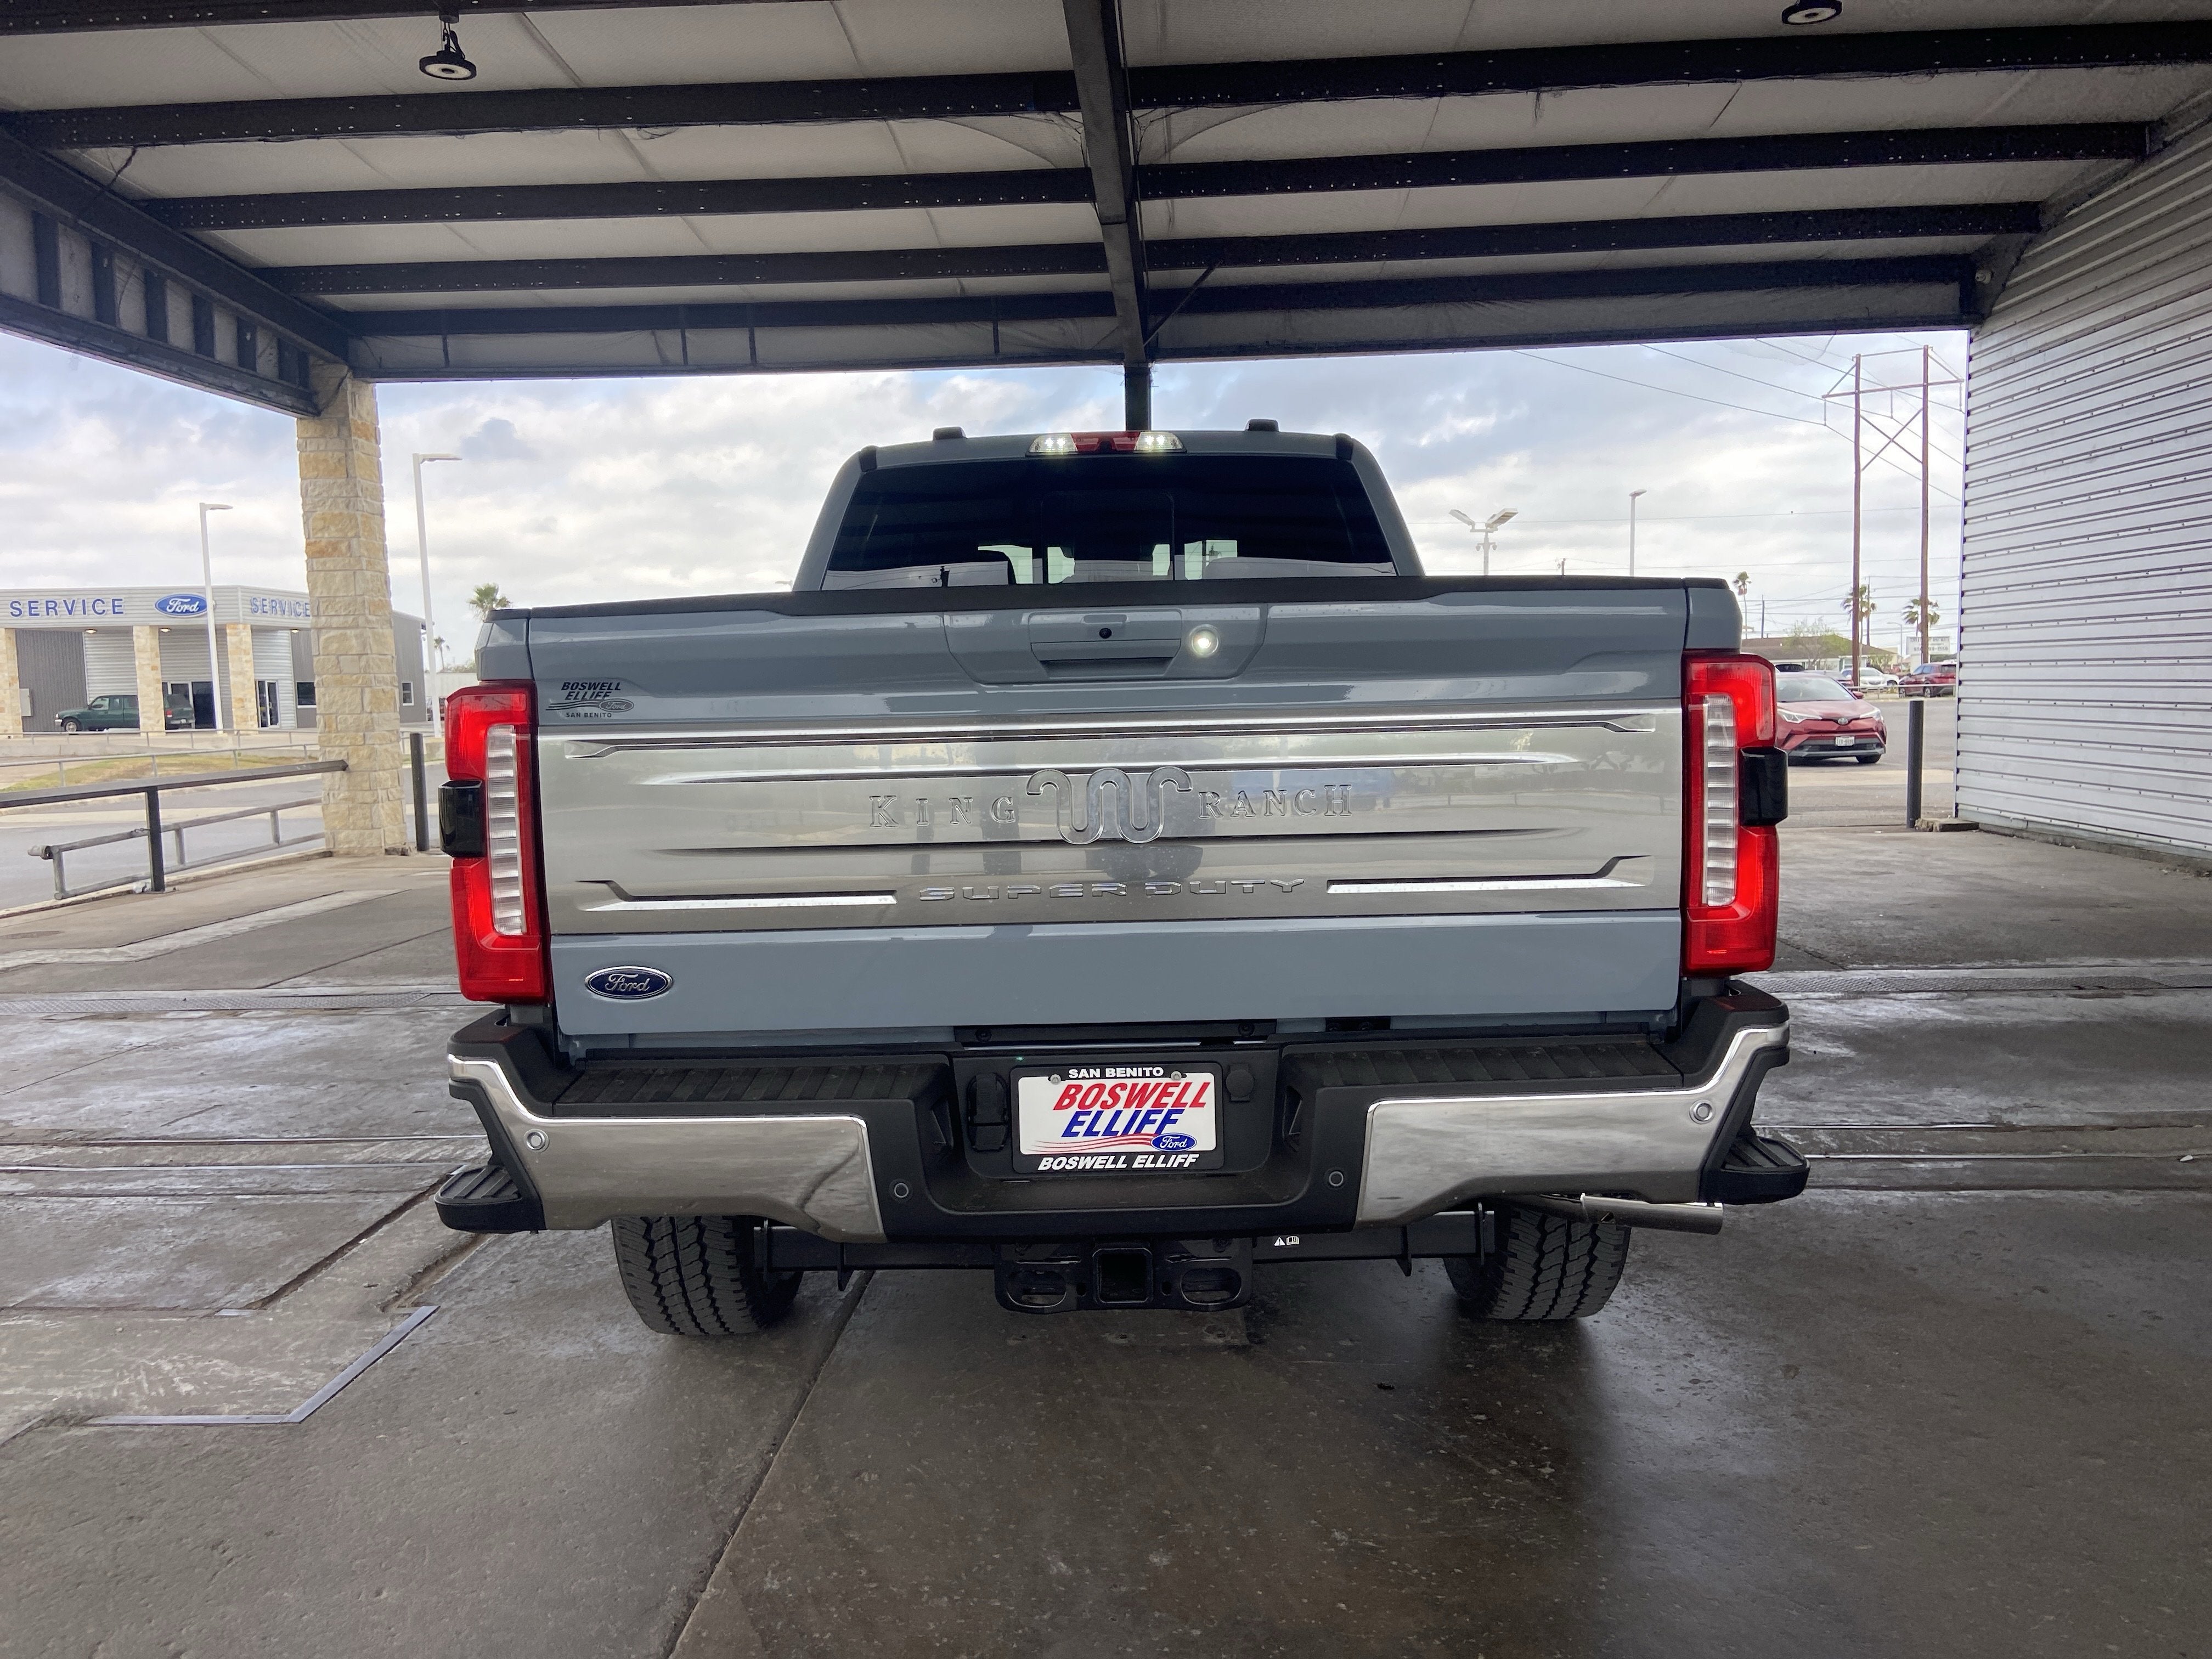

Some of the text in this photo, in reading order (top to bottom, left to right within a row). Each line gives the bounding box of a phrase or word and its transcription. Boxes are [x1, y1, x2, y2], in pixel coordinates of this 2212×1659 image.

[10, 598, 125, 617] SERVICE
[166, 597, 200, 613] Ford
[251, 597, 311, 617] SERVICE
[561, 682, 622, 691] BOSWELL
[565, 691, 612, 701] ELLIFF
[869, 784, 1352, 828] KING RANCH
[919, 879, 1305, 901] SUPER DUTY
[1068, 1066, 1164, 1079] SAN BENITO
[1053, 1082, 1211, 1110] BOSWELL
[1061, 1109, 1185, 1138] ELLIFF
[1159, 1136, 1187, 1149] Ford
[1037, 1154, 1200, 1171] BOSWELL ELLIFF
